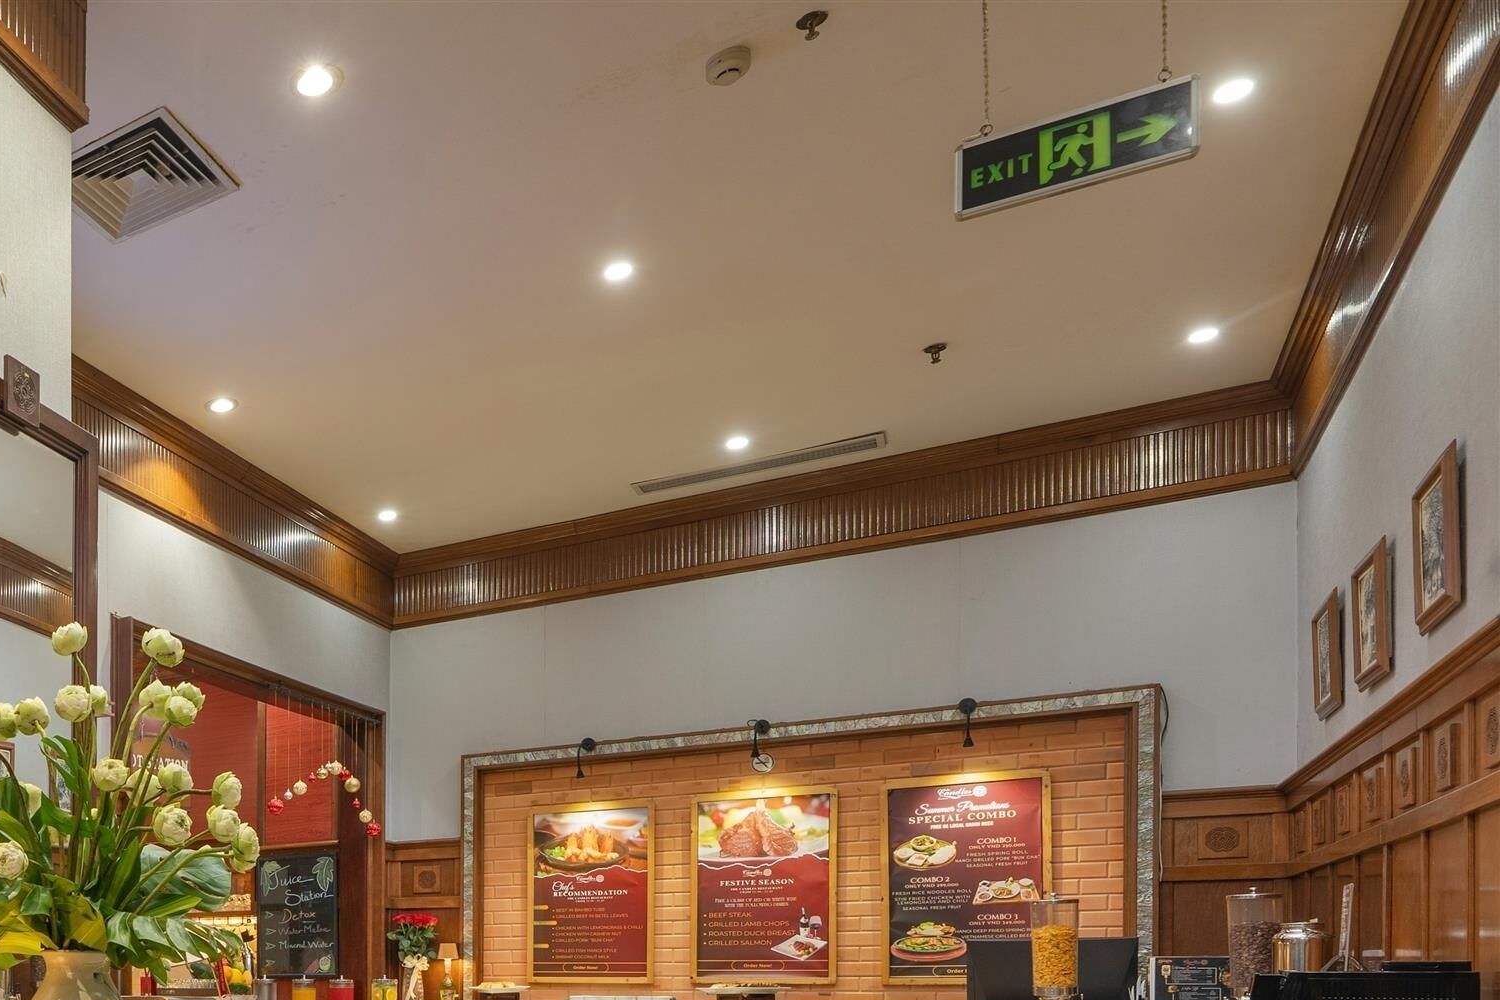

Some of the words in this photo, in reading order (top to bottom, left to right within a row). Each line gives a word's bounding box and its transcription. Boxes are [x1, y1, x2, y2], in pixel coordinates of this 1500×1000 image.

[970, 153, 1033, 189] EXIT
[915, 804, 955, 815] Summer
[957, 801, 1011, 812] Promotions
[909, 814, 963, 825] SPECIAL
[968, 810, 1017, 820] COMBO
[268, 865, 314, 889] Juice
[285, 889, 334, 906] Station
[278, 909, 316, 924] Detox
[307, 941, 335, 949] Water
